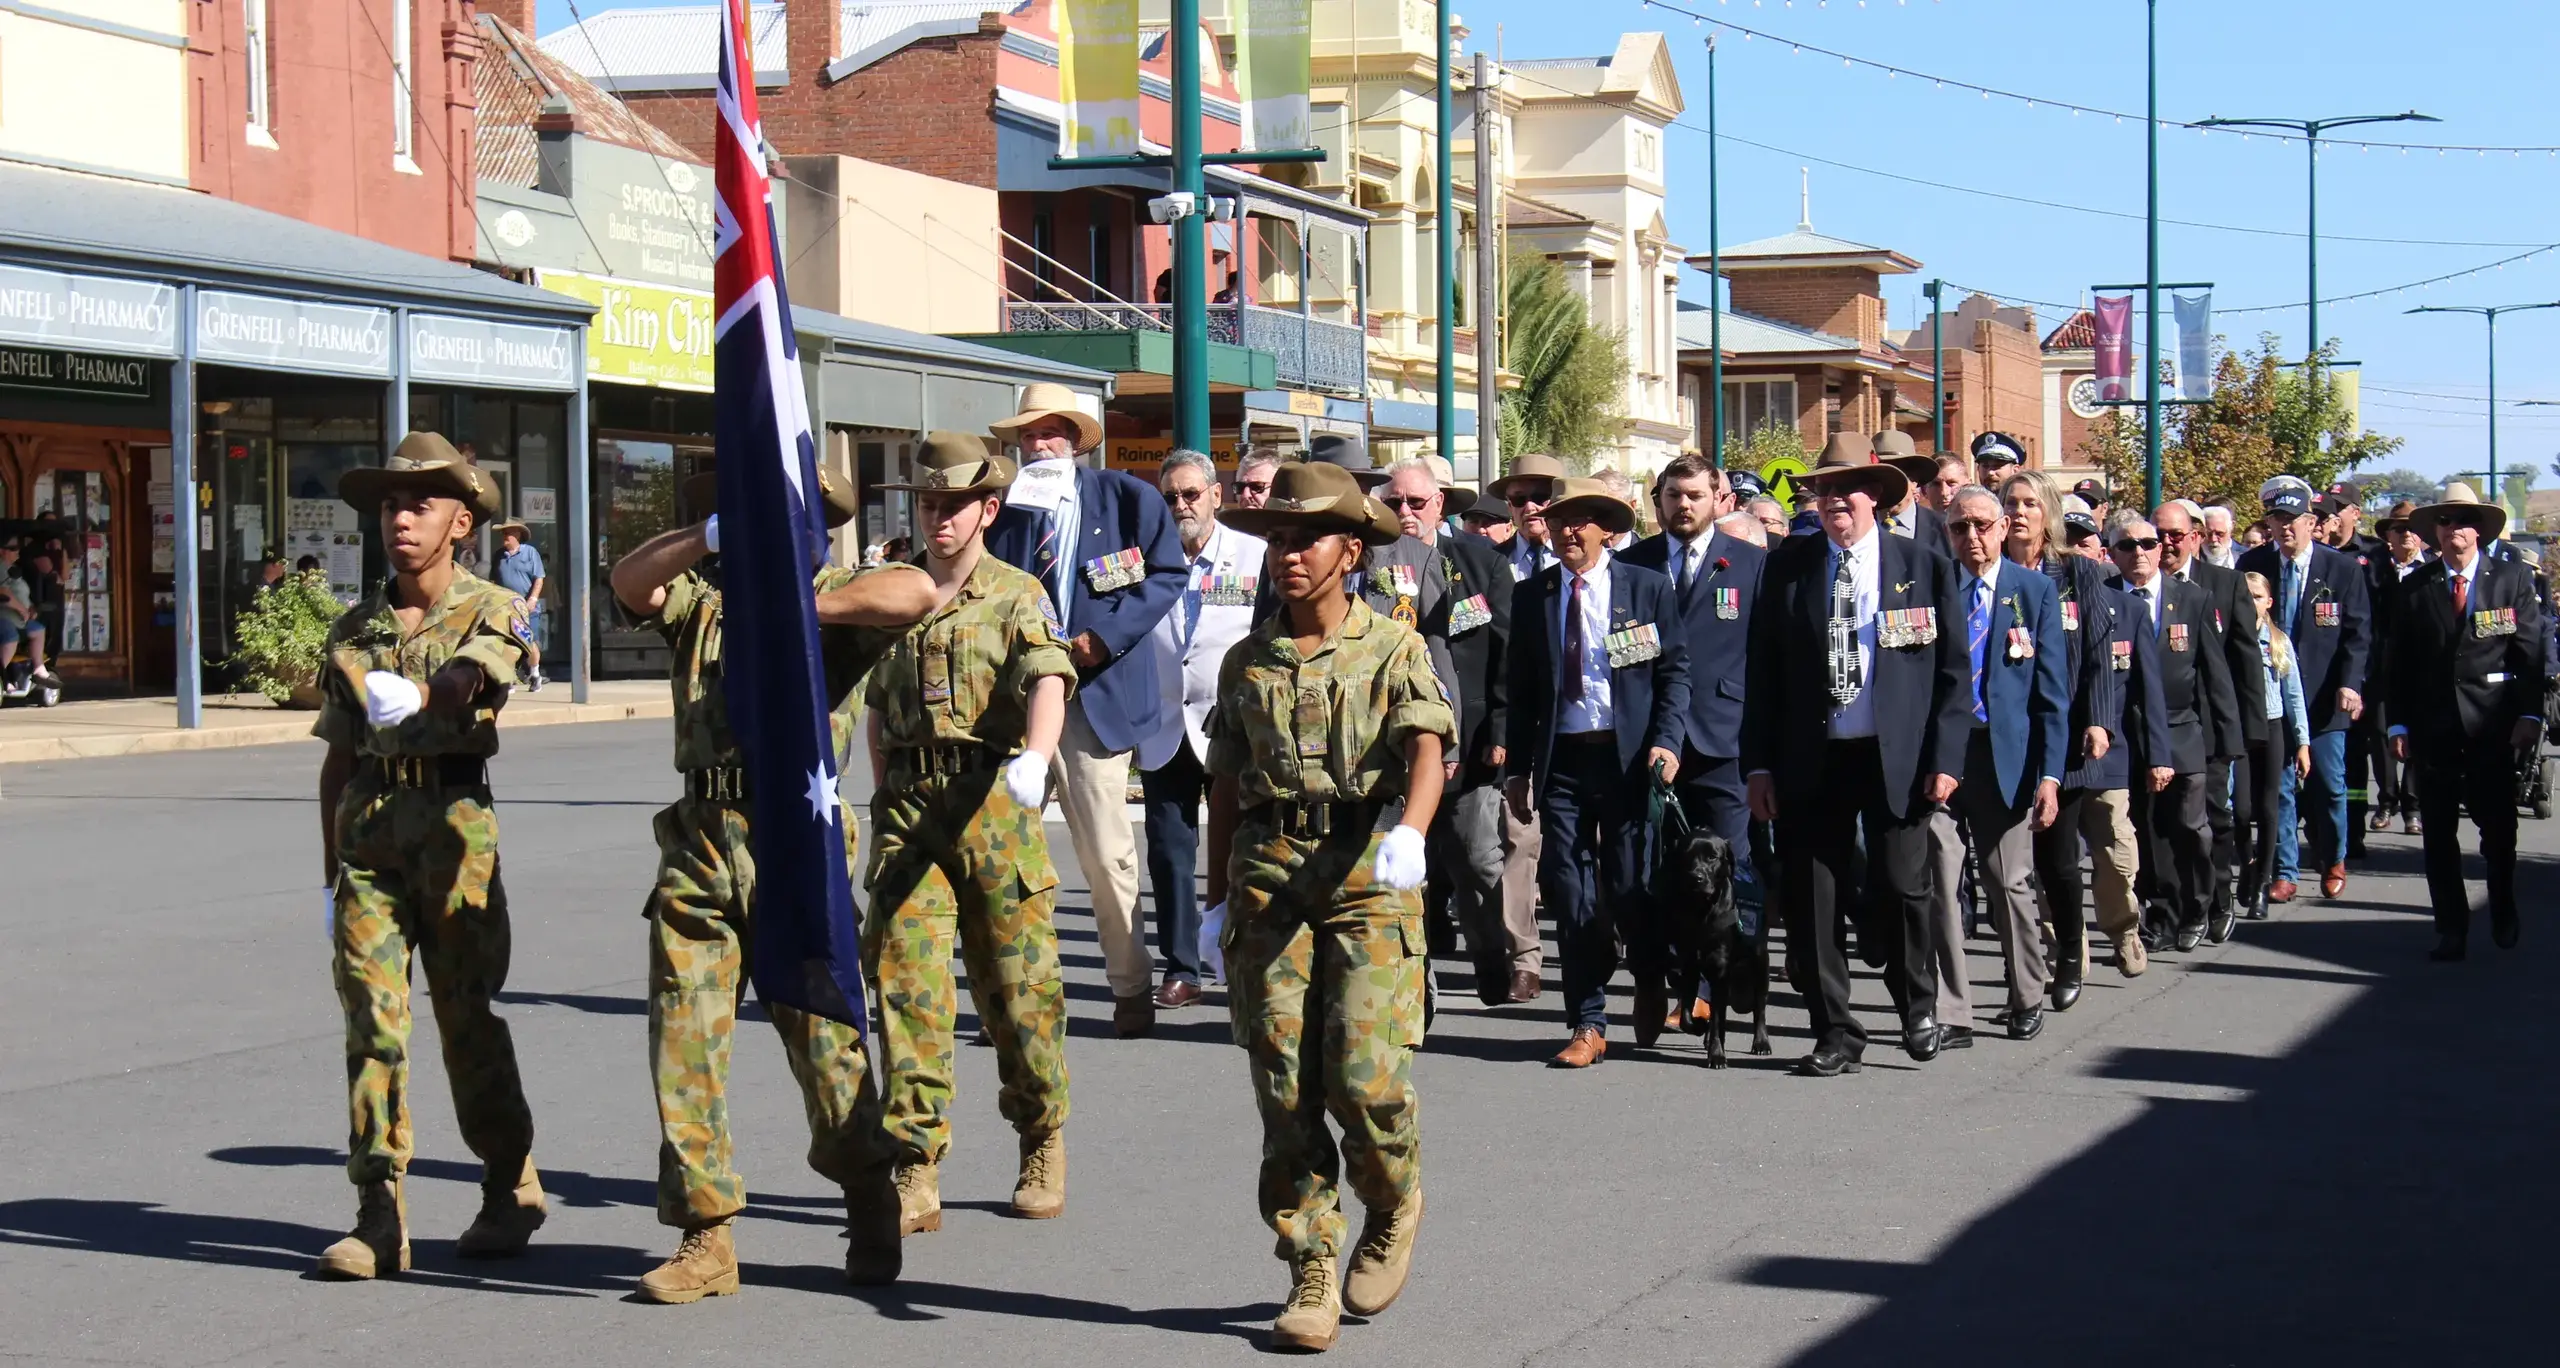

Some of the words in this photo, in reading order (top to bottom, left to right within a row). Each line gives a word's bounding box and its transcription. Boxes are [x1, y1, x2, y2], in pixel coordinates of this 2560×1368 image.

[622, 183, 697, 222] S.PROCTER
[701, 202, 711, 225] &
[609, 212, 640, 244] Books,
[642, 219, 690, 256] Stationery
[642, 248, 676, 276] Musical
[70, 291, 168, 332] PHARMACY
[205, 306, 284, 344] GRENFELL
[298, 317, 383, 355] PHARMACY
[601, 286, 659, 357] Kim
[667, 296, 711, 367] Chi
[66, 353, 146, 386] PHARMACY
[416, 329, 485, 364] GRENFELL
[495, 337, 566, 370] PHARMACY
